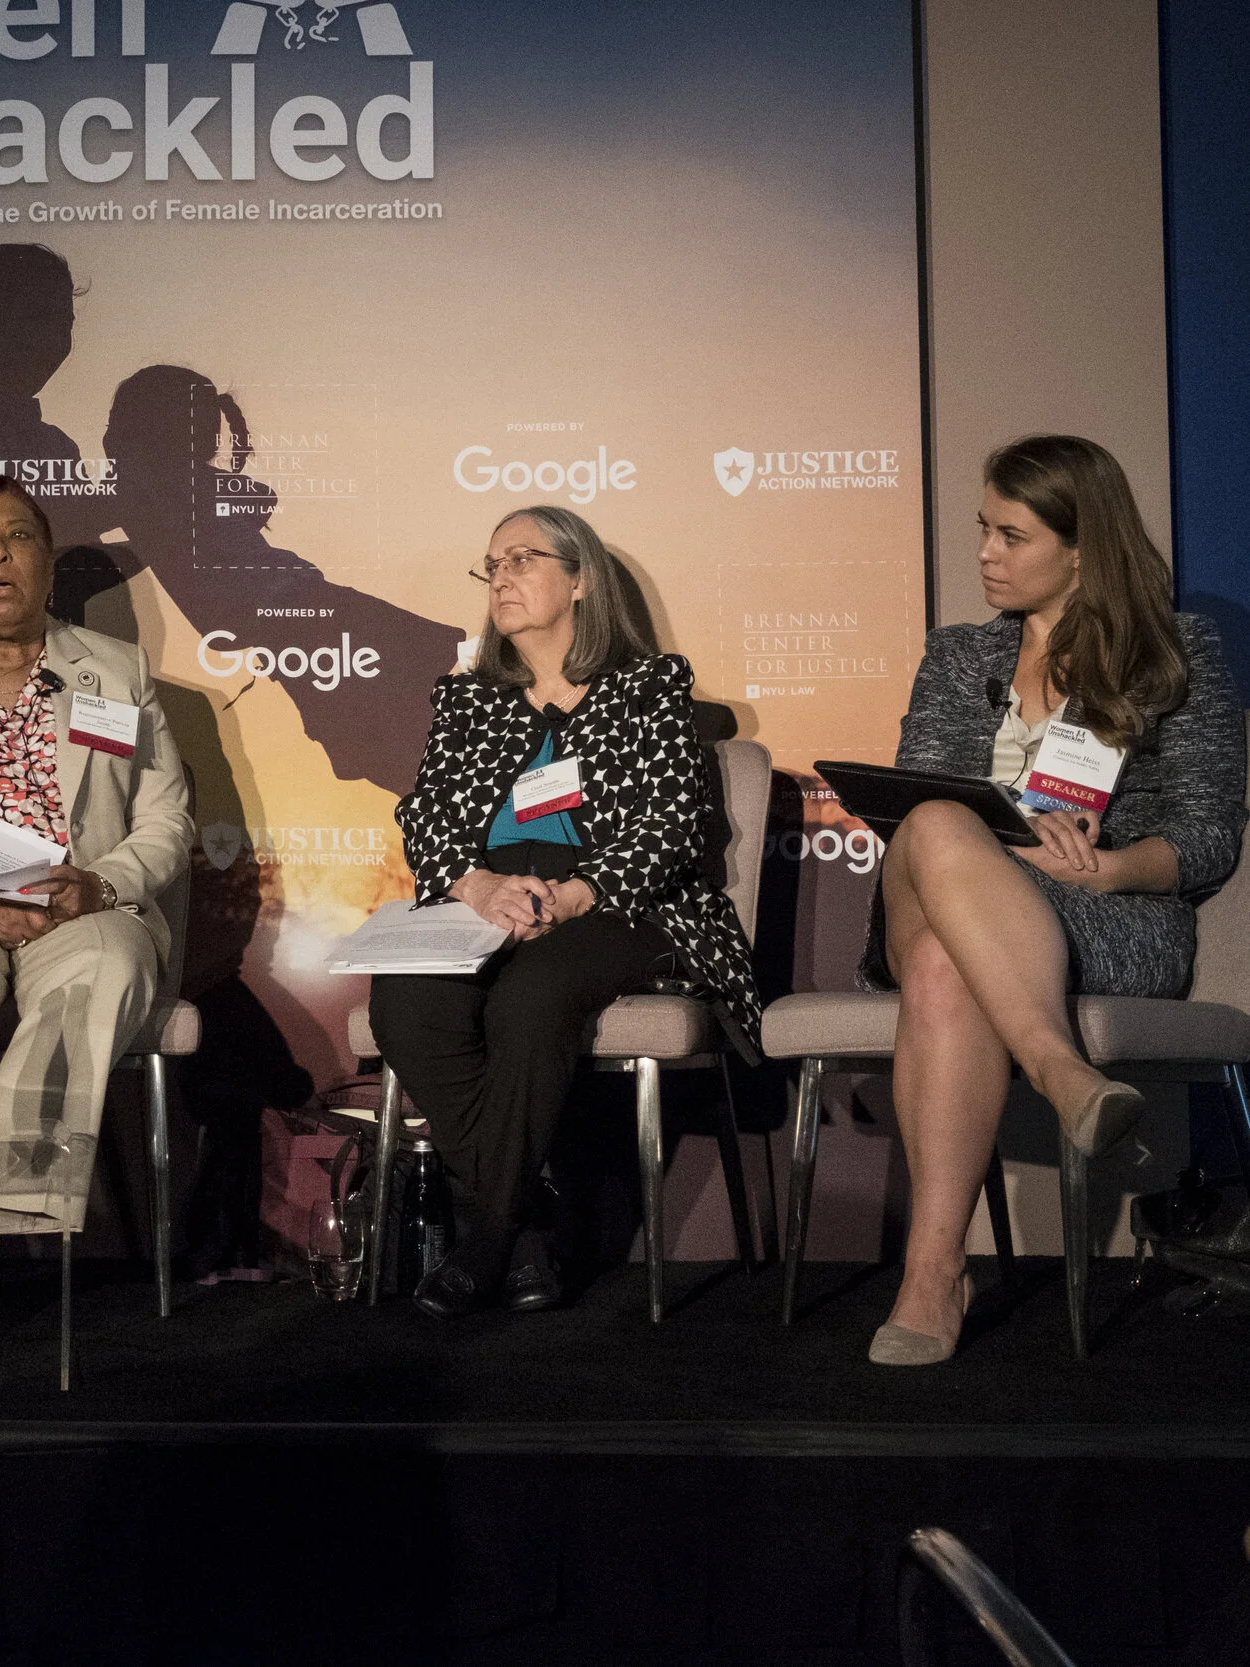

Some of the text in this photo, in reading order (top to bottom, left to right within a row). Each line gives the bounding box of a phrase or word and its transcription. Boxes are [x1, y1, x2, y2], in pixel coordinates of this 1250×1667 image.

[28, 200, 124, 224] Growth
[131, 199, 158, 222] of
[165, 198, 260, 221] Female
[268, 198, 444, 220] Incarceration
[507, 422, 584, 432] POWERED BY
[215, 433, 328, 448] BRENNAN
[214, 455, 303, 470] CENTER
[756, 450, 899, 475] JUSTICE
[453, 444, 637, 505] Google
[40, 483, 118, 497] NETWORK
[216, 478, 357, 494] FOR JUSTICE
[757, 475, 899, 491] ACTION NETWORK
[231, 505, 284, 514] NYU LAW
[256, 608, 335, 618] POWERED BY
[744, 612, 858, 629] BRENNAN
[743, 635, 834, 651] CENTER
[197, 629, 381, 692] Google
[745, 657, 888, 676] FOR JUSTICE
[762, 686, 815, 696] NYU LAW
[1048, 730, 1086, 744] Unshackled
[1049, 724, 1074, 735] Women
[1040, 778, 1096, 803] SPEAKER
[246, 852, 387, 867] ACTION NETWORK
